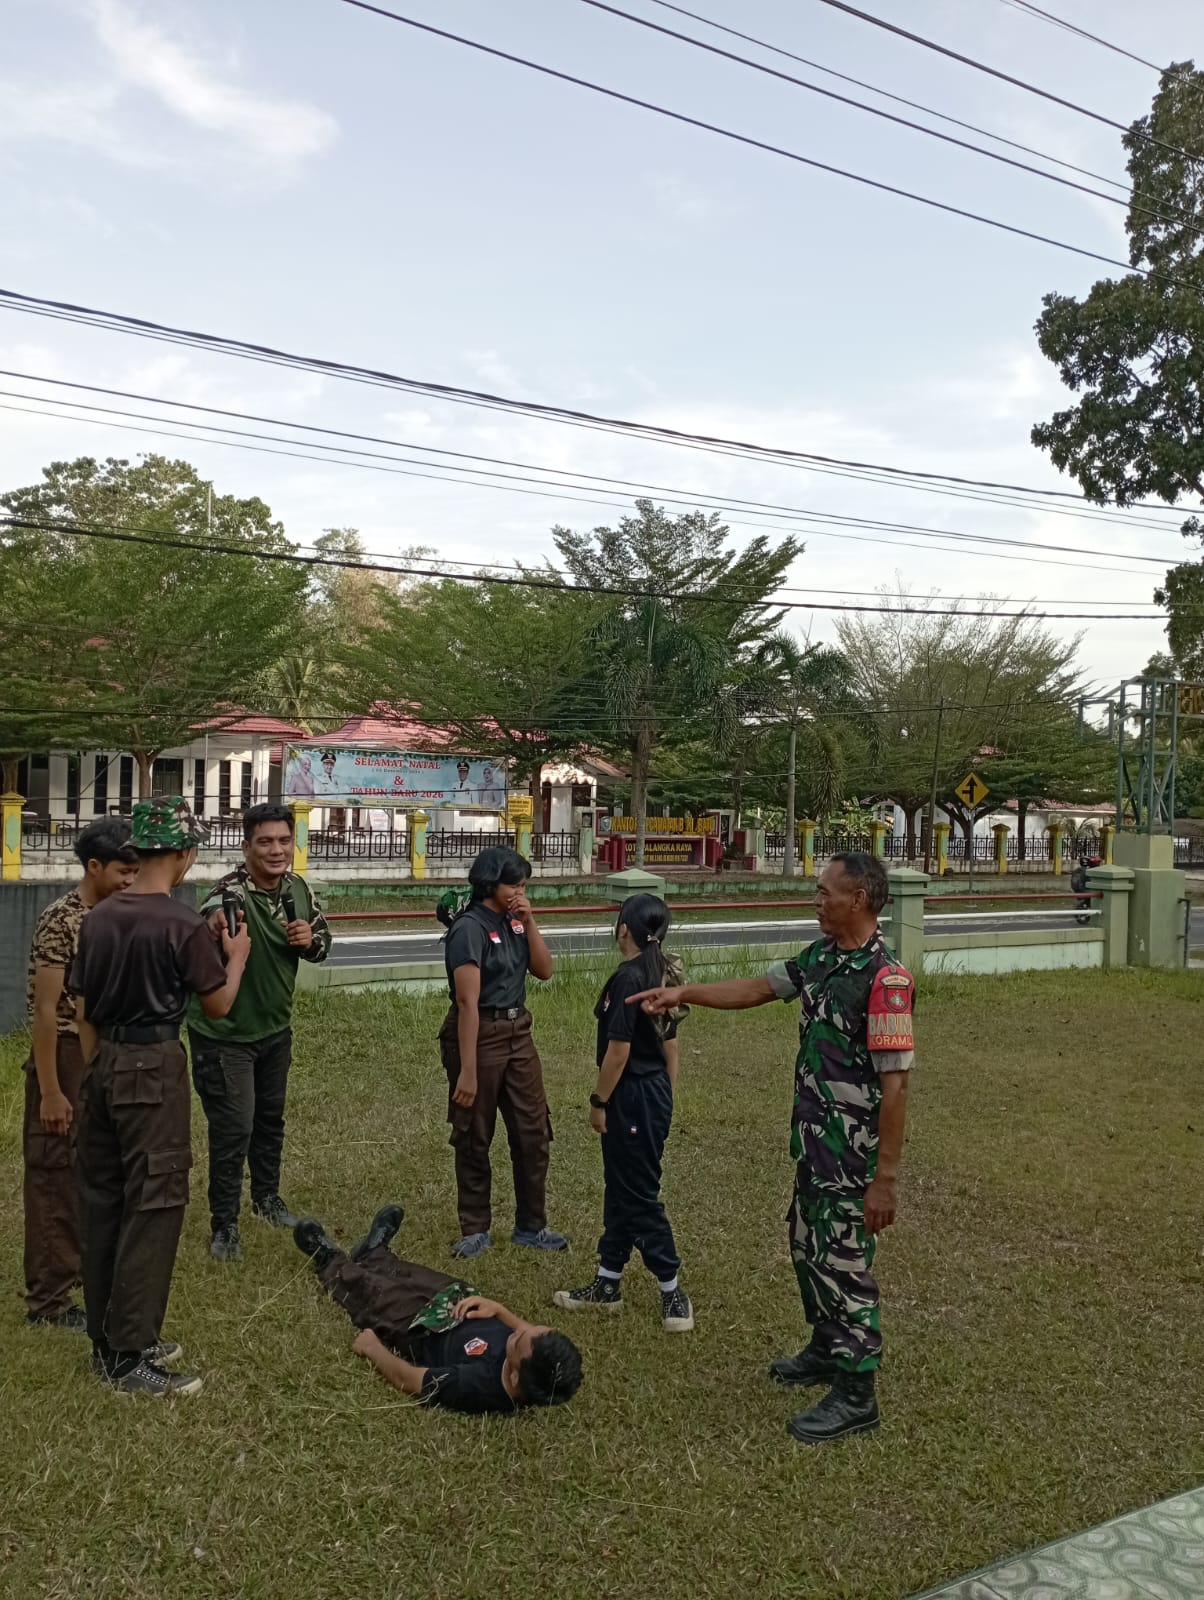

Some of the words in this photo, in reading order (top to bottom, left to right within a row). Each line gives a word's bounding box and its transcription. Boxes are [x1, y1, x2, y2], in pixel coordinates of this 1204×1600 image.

[355, 757, 404, 768] SELAMAT
[409, 760, 441, 770] NATAL
[394, 775, 404, 786] &
[351, 787, 387, 797] TAHUN
[420, 791, 444, 799] 2026
[611, 816, 637, 832] KANTO
[625, 843, 636, 852] KOT
[645, 843, 675, 852] ALANGKA
